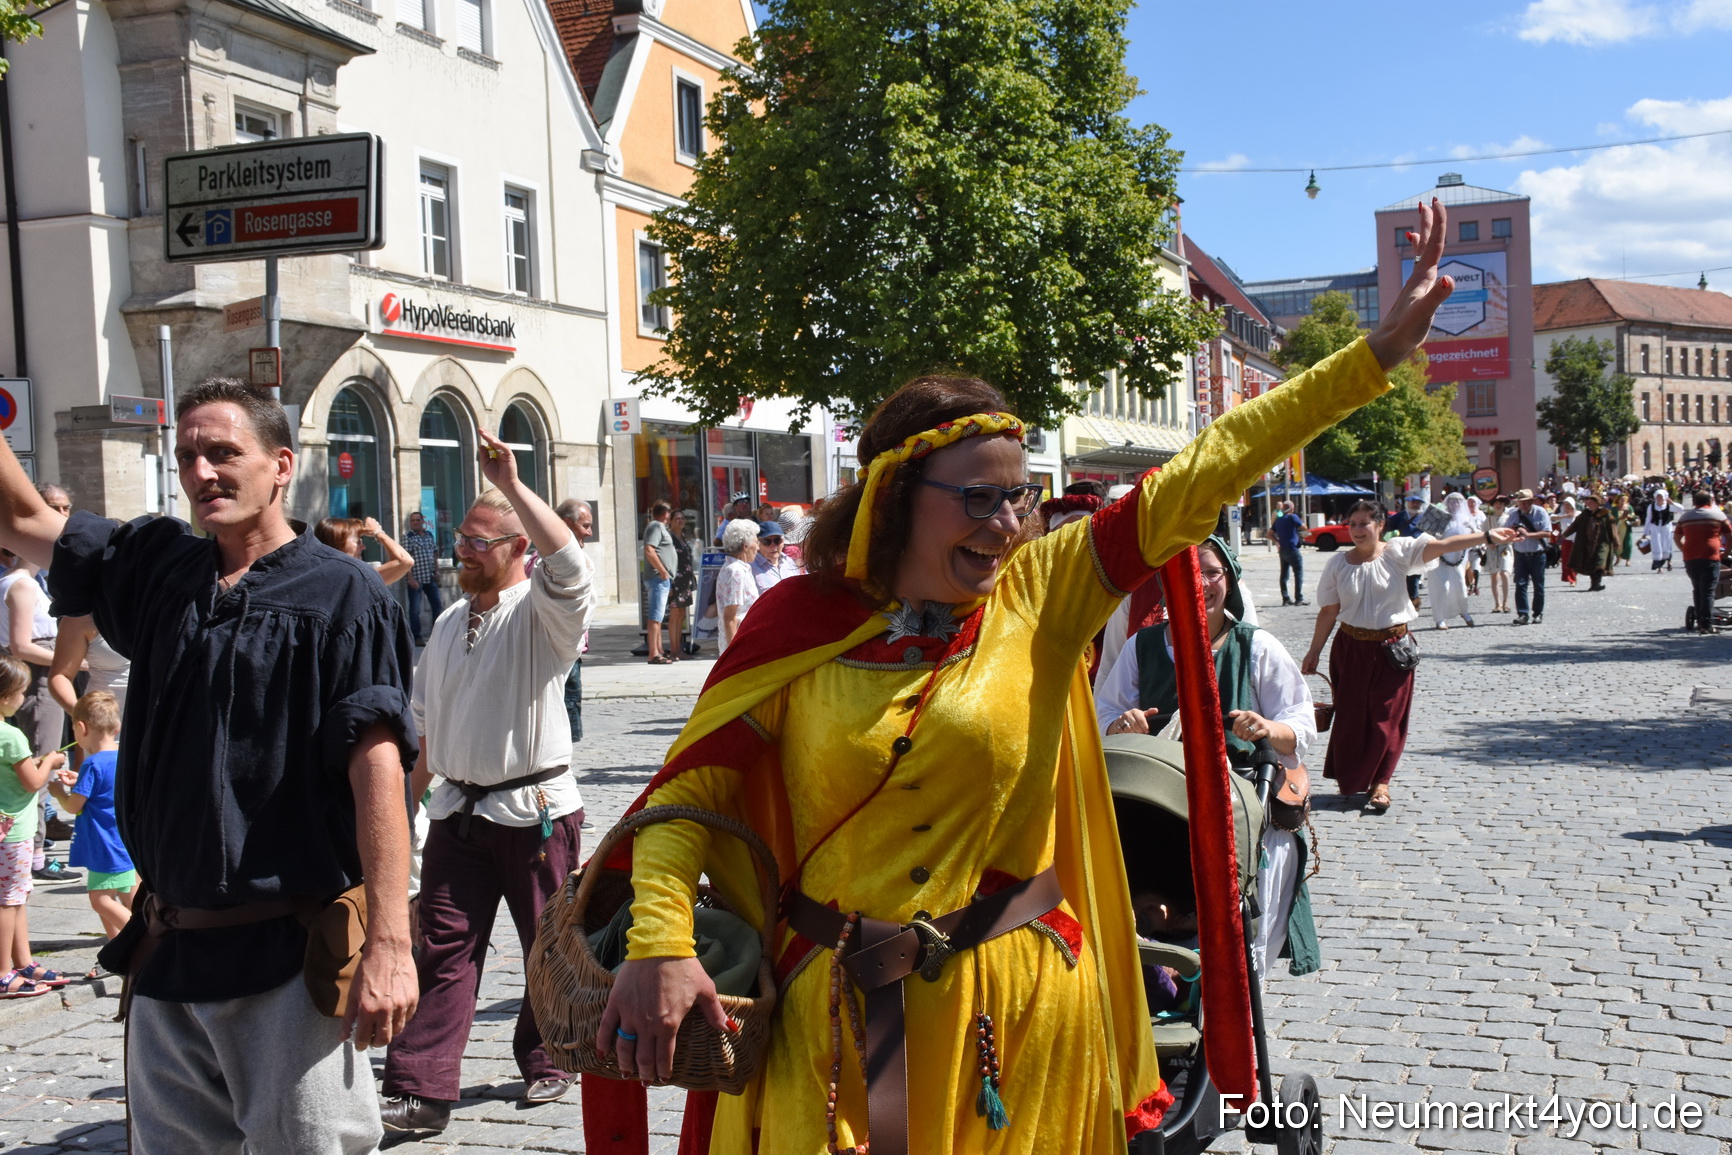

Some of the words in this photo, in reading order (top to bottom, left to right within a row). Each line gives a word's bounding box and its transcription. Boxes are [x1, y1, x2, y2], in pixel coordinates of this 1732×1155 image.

[198, 156, 331, 192] Parkleitsystem
[213, 221, 225, 242] P
[244, 209, 333, 236] Rosengasse
[226, 305, 262, 327] Rosengass
[402, 297, 516, 339] HypoVereinsbank
[614, 401, 628, 417] EC
